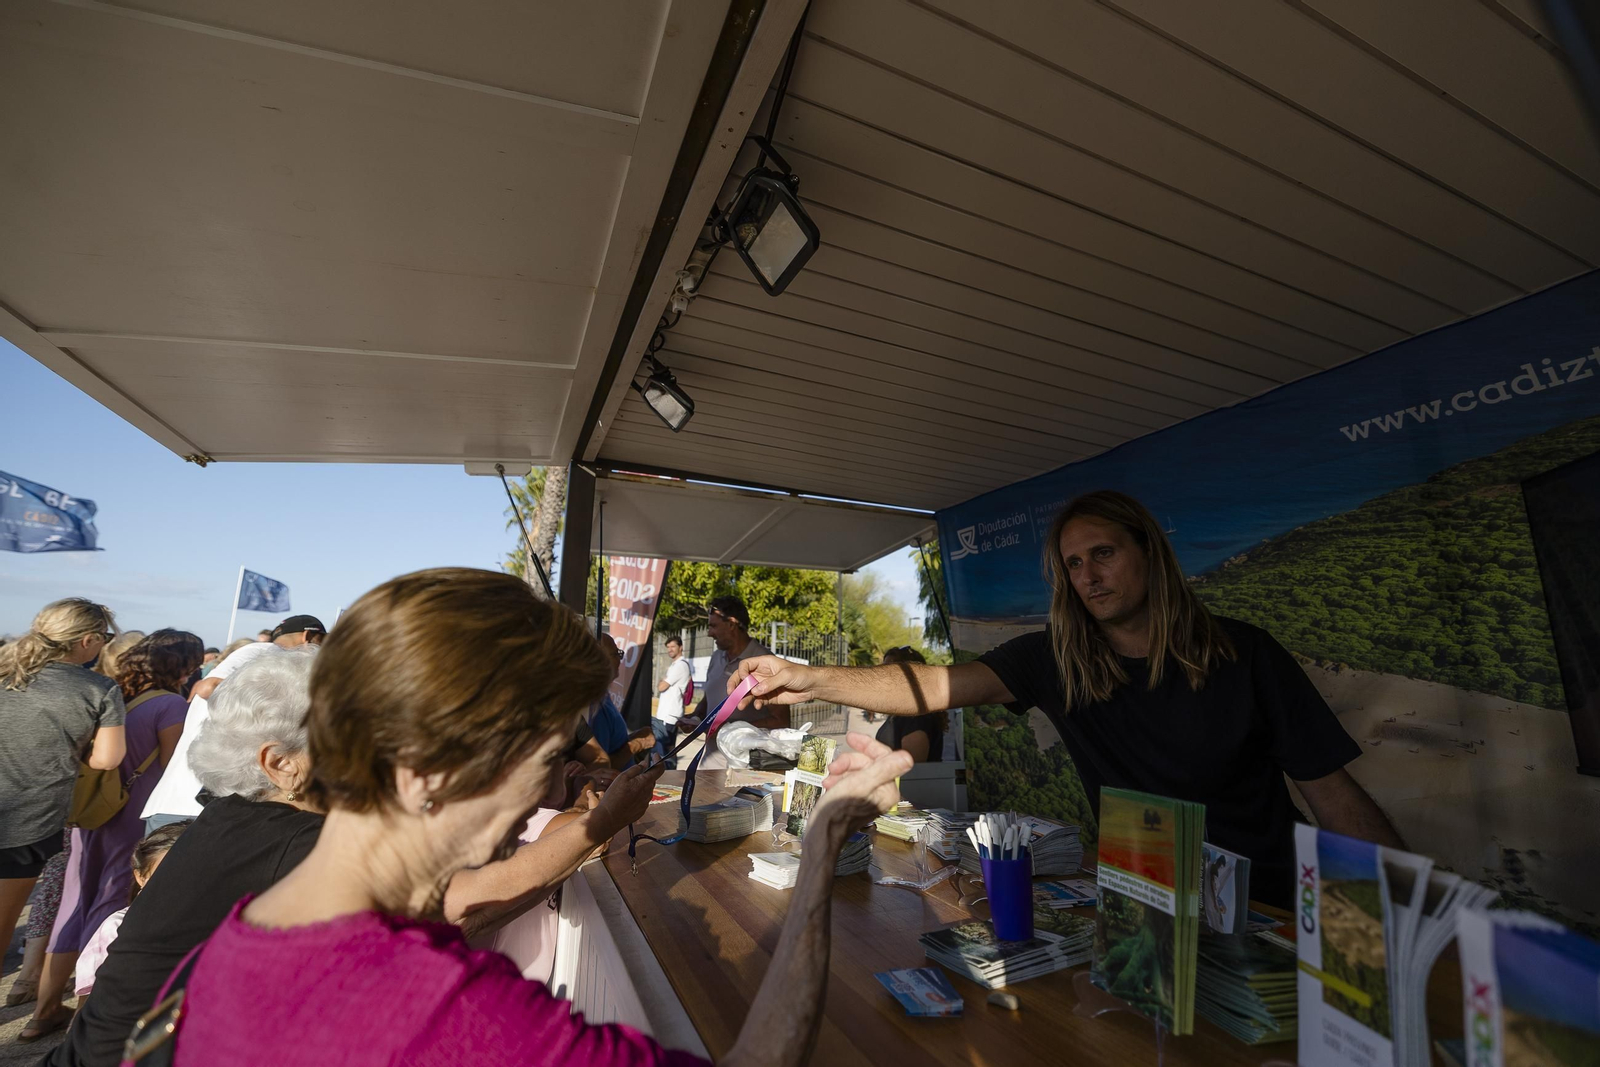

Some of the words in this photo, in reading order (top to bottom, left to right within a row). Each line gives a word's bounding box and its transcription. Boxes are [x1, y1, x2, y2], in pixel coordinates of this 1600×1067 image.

[977, 512, 1027, 536] Diputación
[981, 539, 993, 553] de
[994, 532, 1020, 550] Cádiz
[1099, 867, 1119, 880] Sentiers
[1098, 876, 1107, 884] des
[1108, 879, 1129, 893] Espaces
